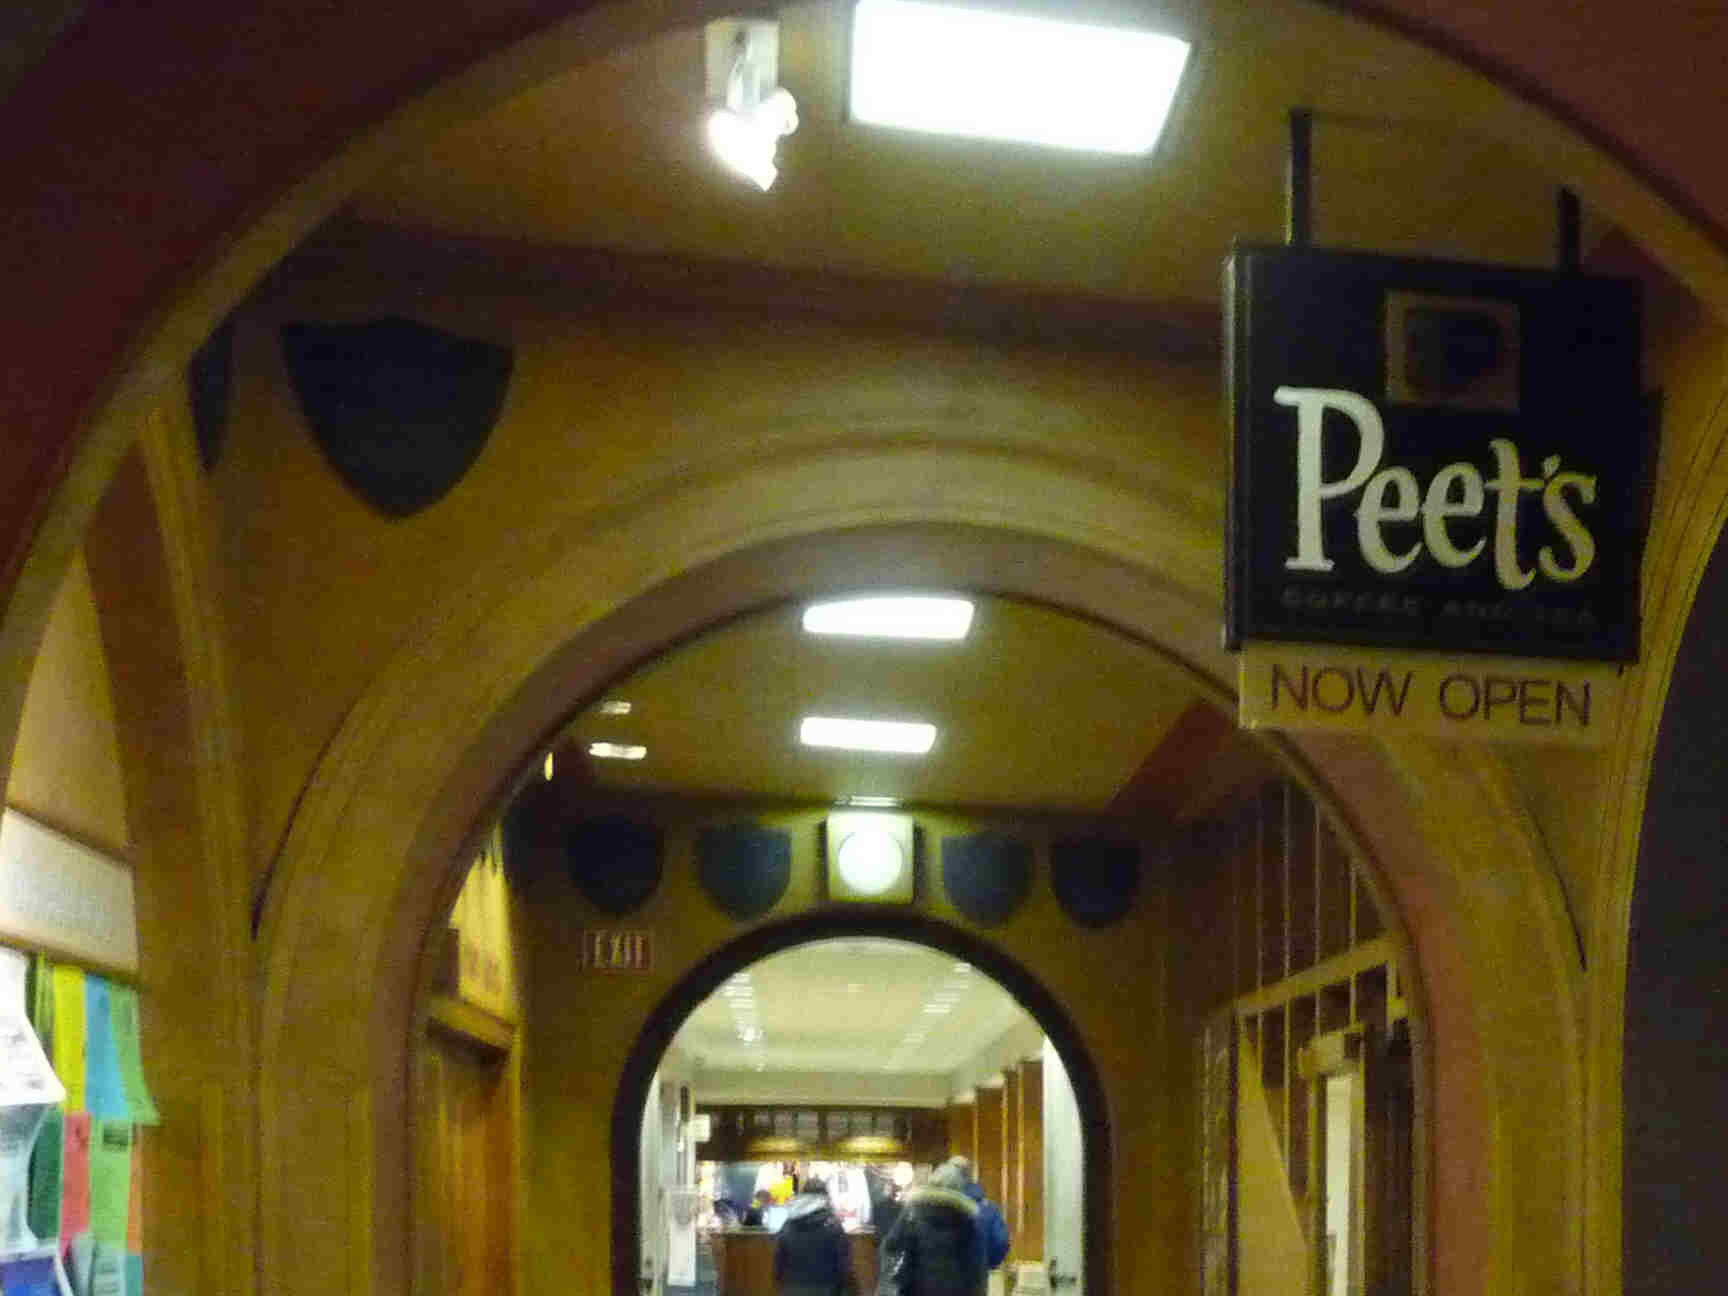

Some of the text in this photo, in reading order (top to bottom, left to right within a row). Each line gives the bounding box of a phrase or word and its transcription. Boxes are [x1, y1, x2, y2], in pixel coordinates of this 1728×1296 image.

[1273, 386, 1597, 589] Peet's
[1271, 664, 1591, 727] NOW OPEN
